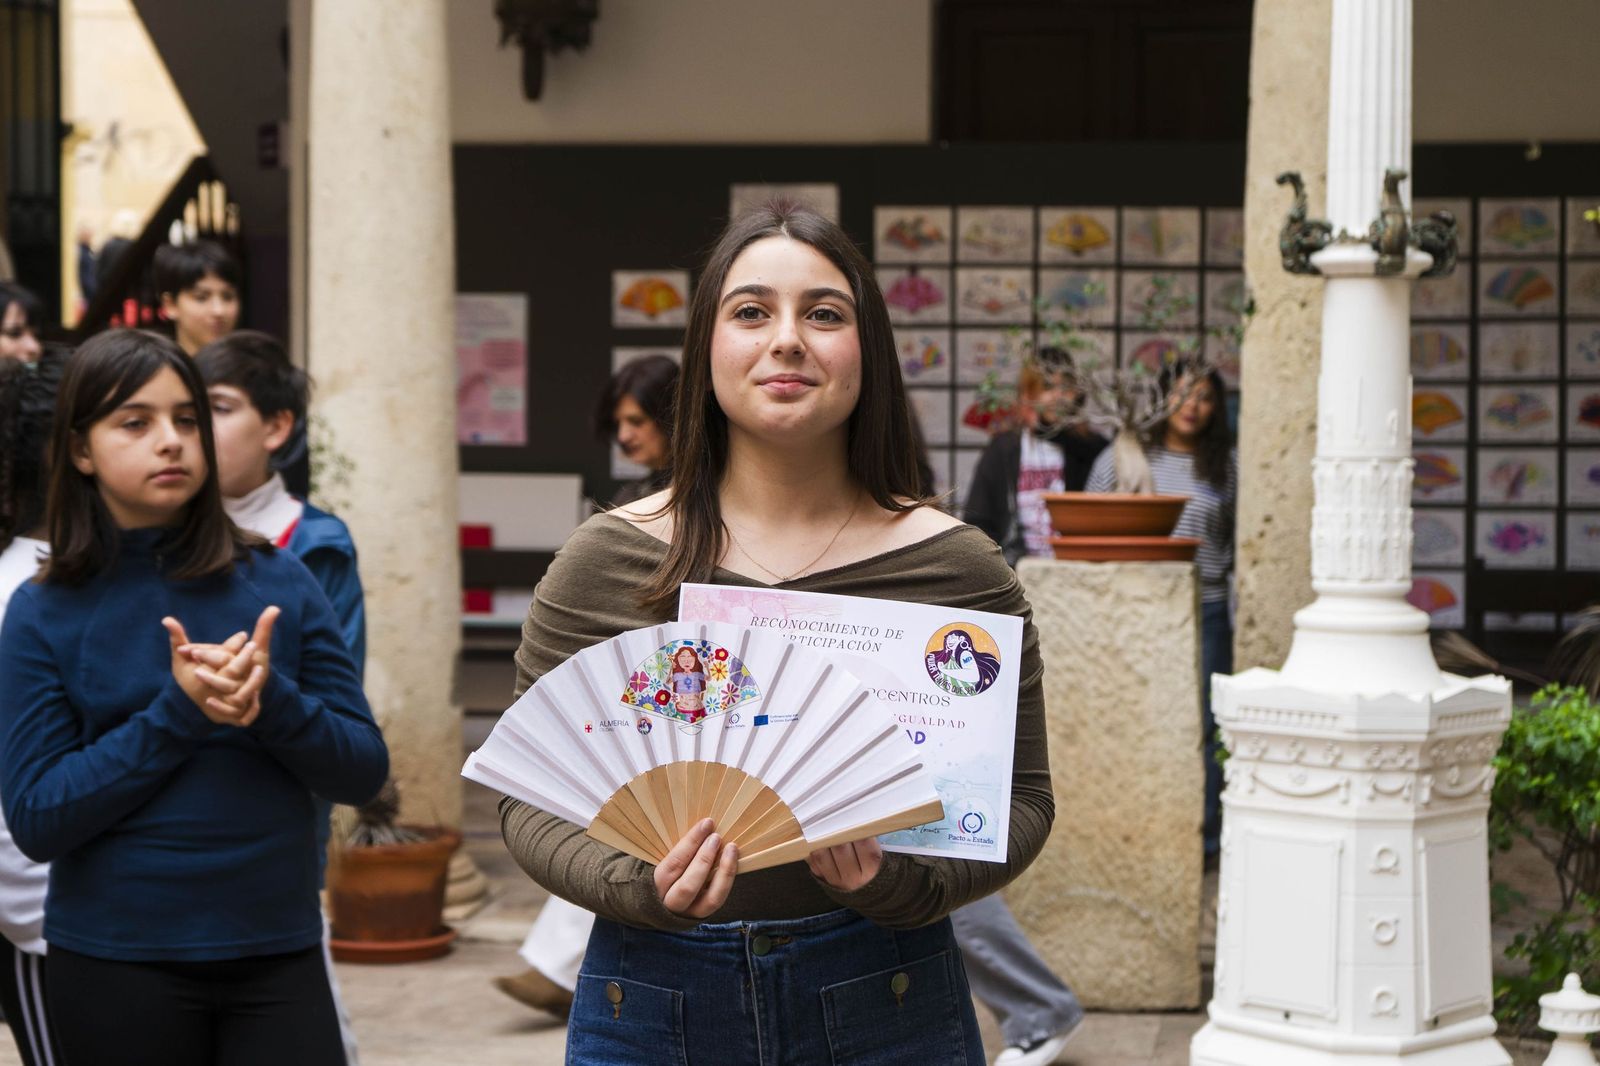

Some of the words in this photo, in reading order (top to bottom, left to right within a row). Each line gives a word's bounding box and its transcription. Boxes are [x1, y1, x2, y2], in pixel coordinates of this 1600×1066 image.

[750, 616, 880, 638] RECONOCIMIENTO
[884, 628, 905, 640] DE
[782, 633, 883, 653] RTICIPACIÓN
[893, 713, 966, 729] GUALDAD
[947, 833, 966, 842] Pacto
[972, 836, 994, 845] Estado
